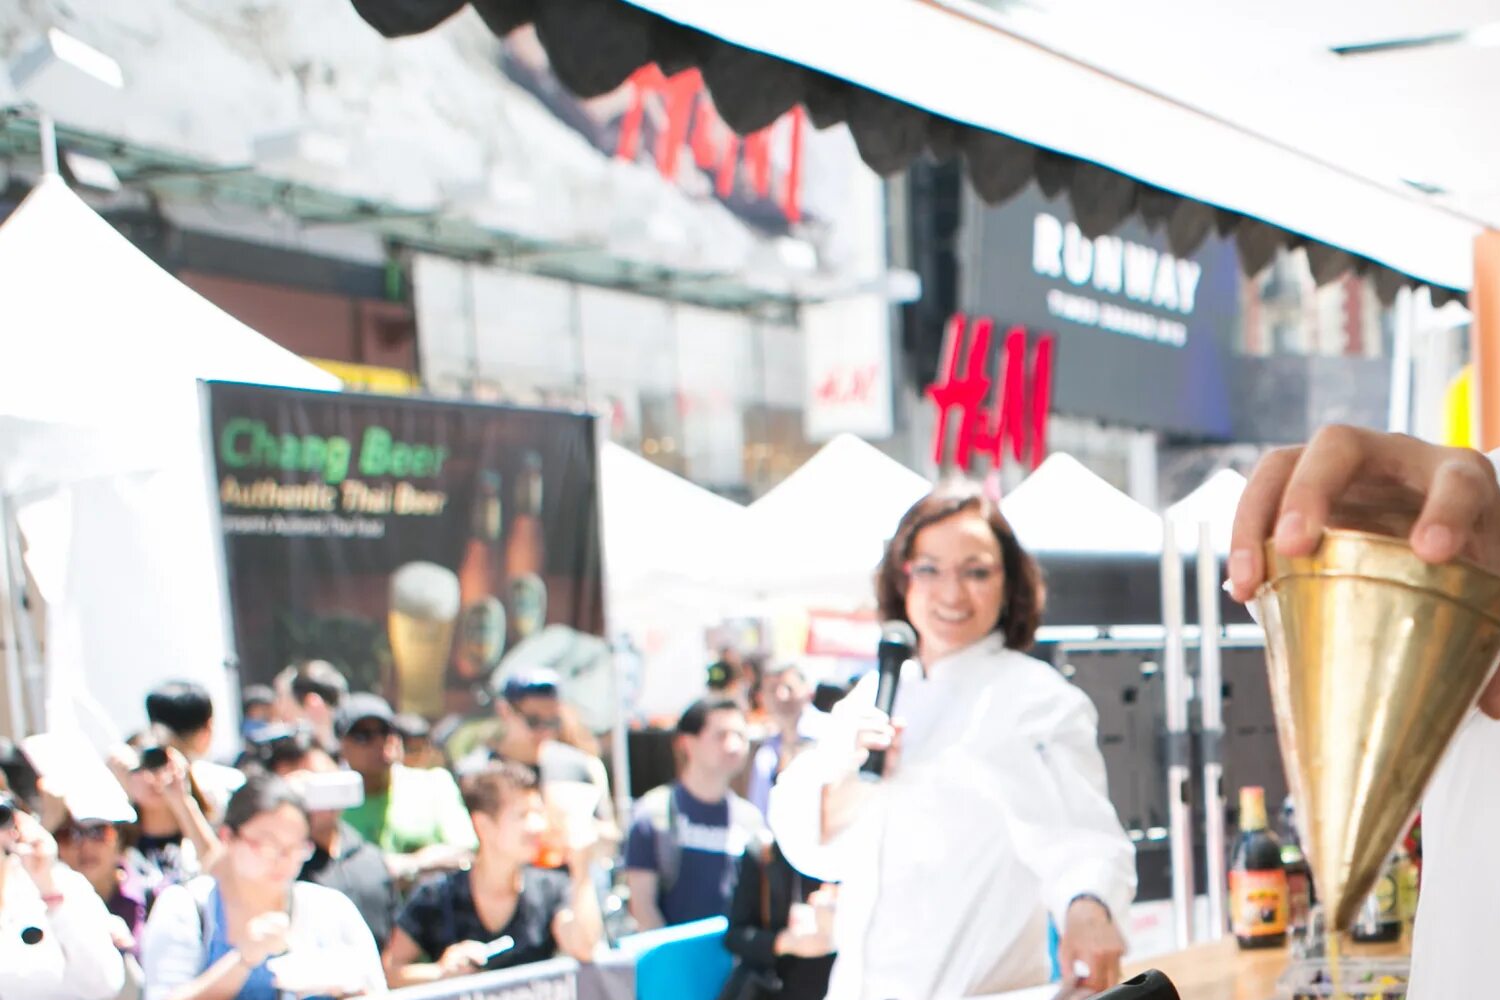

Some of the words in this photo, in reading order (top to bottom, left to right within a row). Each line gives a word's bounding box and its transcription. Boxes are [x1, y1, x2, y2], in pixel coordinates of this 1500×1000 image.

[1033, 212, 1201, 315] RUNWAY
[926, 312, 1056, 471] H&M
[221, 416, 351, 485] Chang
[359, 424, 447, 478] Beer
[341, 479, 393, 514] Thai
